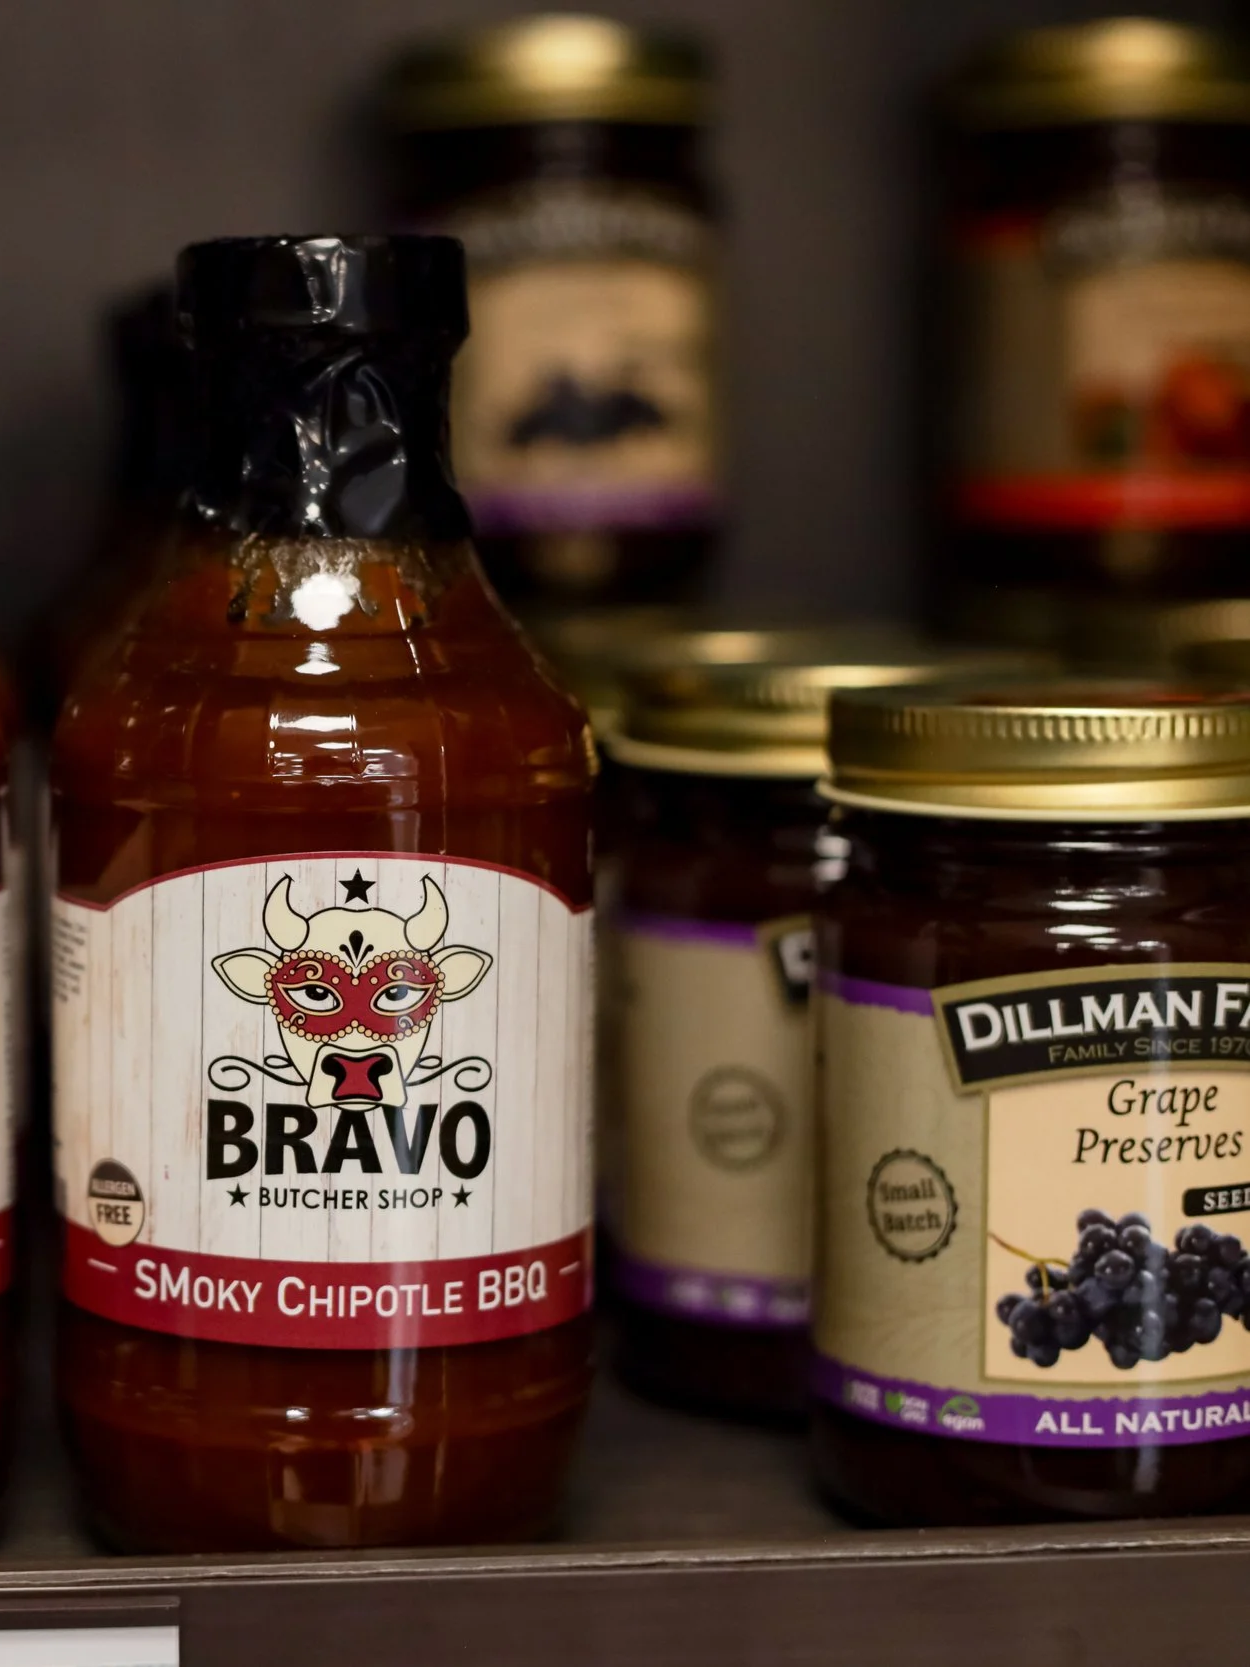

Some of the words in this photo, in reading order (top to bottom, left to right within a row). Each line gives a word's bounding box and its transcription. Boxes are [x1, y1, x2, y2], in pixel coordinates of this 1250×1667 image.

[956, 990, 1202, 1051] DILLMAN
[1048, 1042, 1128, 1063] FAMILY
[1134, 1037, 1202, 1055] SINCE
[1107, 1080, 1219, 1127] Grape
[206, 1099, 492, 1180] BRAVO
[1072, 1128, 1244, 1164] Preserves
[96, 1203, 132, 1225] FREE
[259, 1186, 368, 1209] BUTCHER
[378, 1187, 442, 1209] SHOP
[135, 1259, 262, 1312] SMOKY
[277, 1277, 464, 1318] CHIPOTLE
[478, 1261, 547, 1310] BBQ
[1035, 1411, 1104, 1435] ALL
